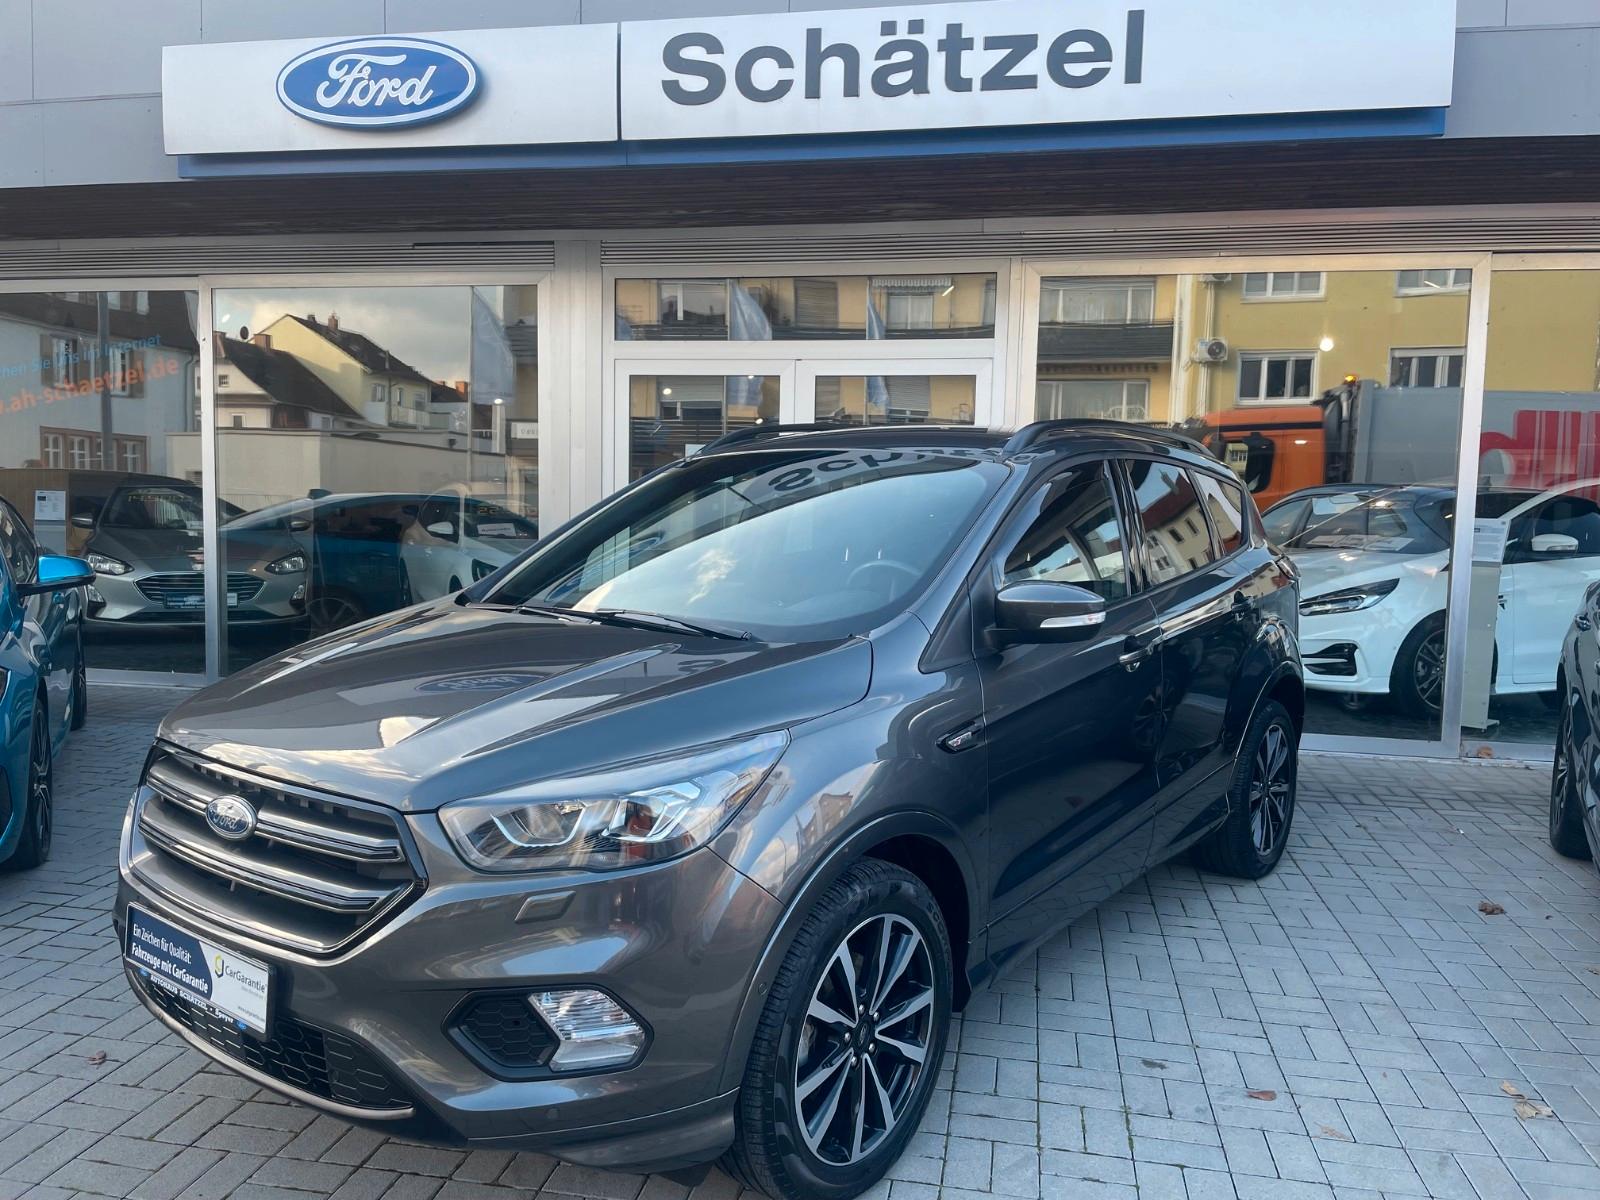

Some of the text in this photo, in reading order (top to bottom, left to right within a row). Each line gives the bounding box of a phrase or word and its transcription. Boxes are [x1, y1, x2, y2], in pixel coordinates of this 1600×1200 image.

[316, 54, 437, 108] Ford
[661, 9, 1146, 106] Schätzel
[103, 334, 161, 356] Internet
[132, 942, 160, 970] Fahrzeuge
[161, 960, 172, 975] mit
[172, 964, 209, 994] CarGarantie
[133, 923, 192, 965] Ein Zeichen für Qualität:
